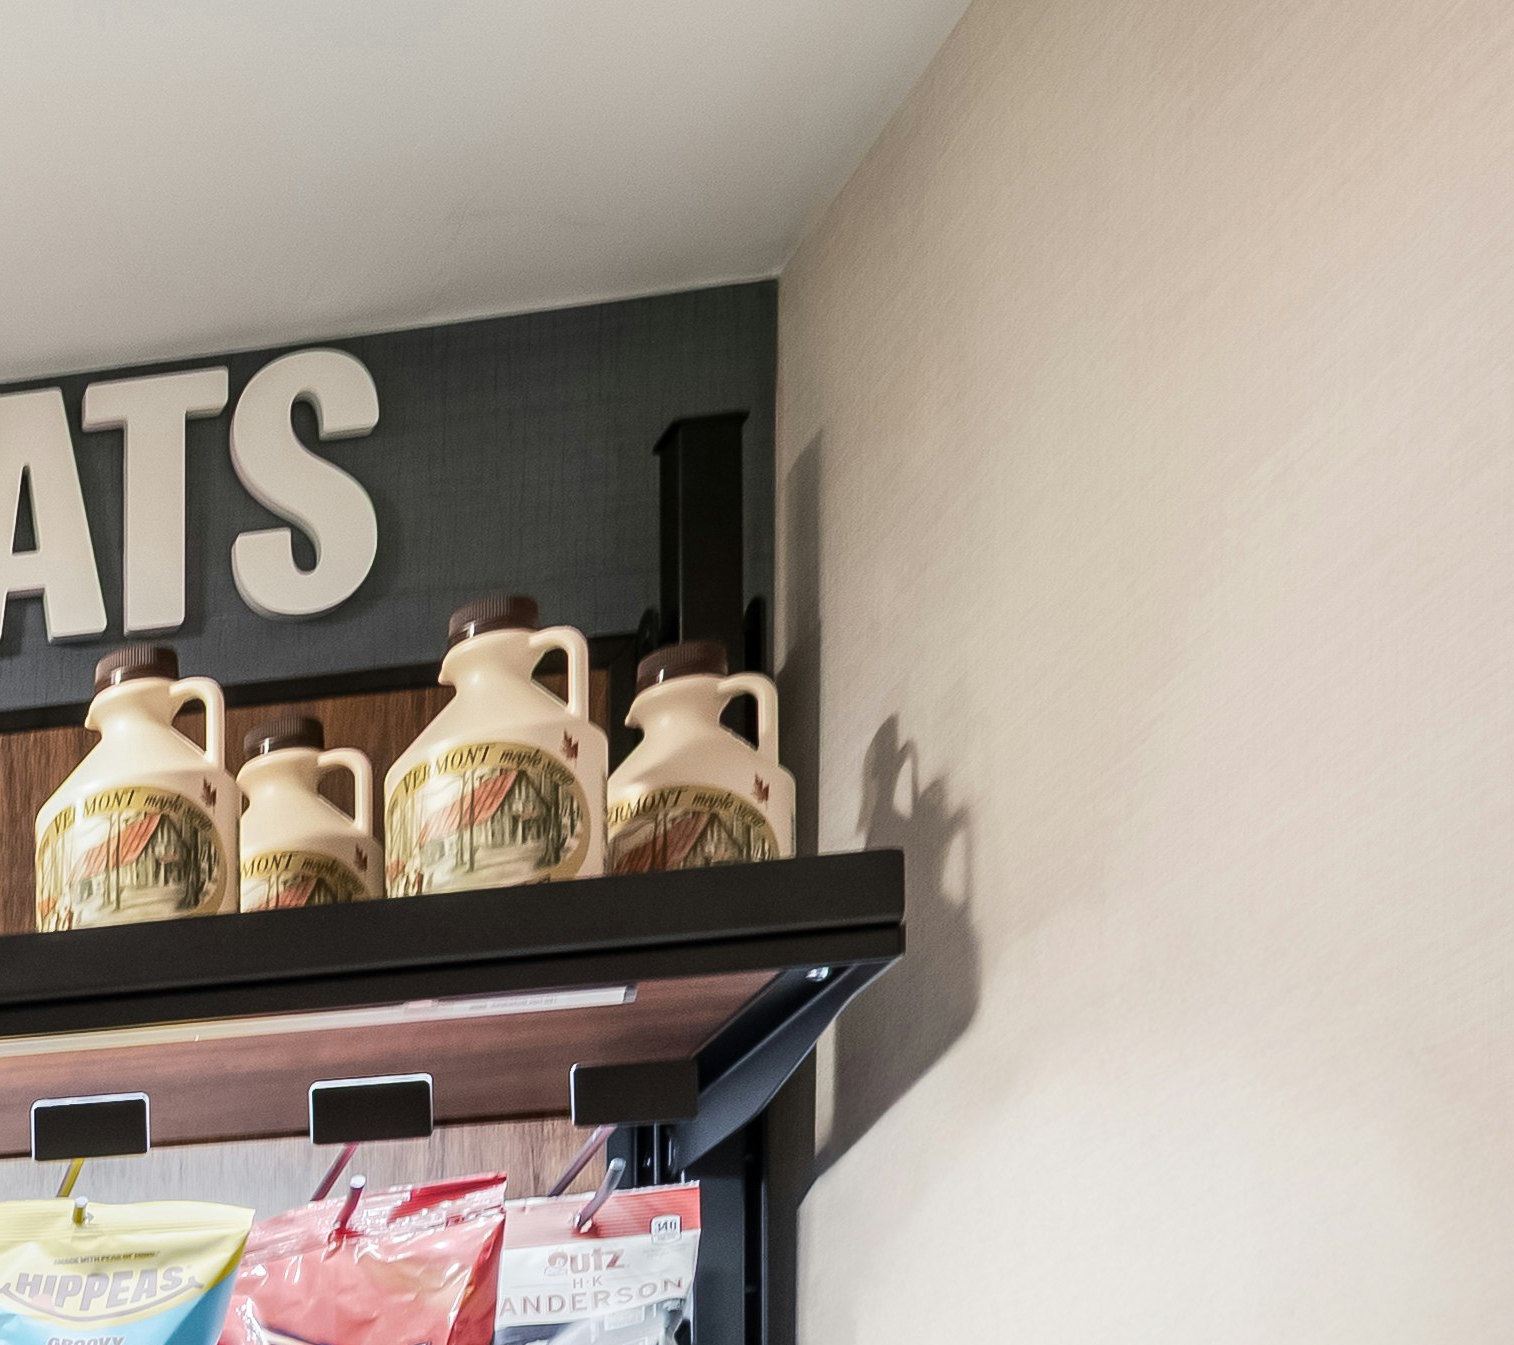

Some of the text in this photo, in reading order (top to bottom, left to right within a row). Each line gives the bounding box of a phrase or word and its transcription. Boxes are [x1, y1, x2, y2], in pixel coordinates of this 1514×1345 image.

[402, 745, 489, 793] VERMONT
[17, 1265, 188, 1312] HIPPEAS
[501, 1278, 684, 1316] ANDERSON
